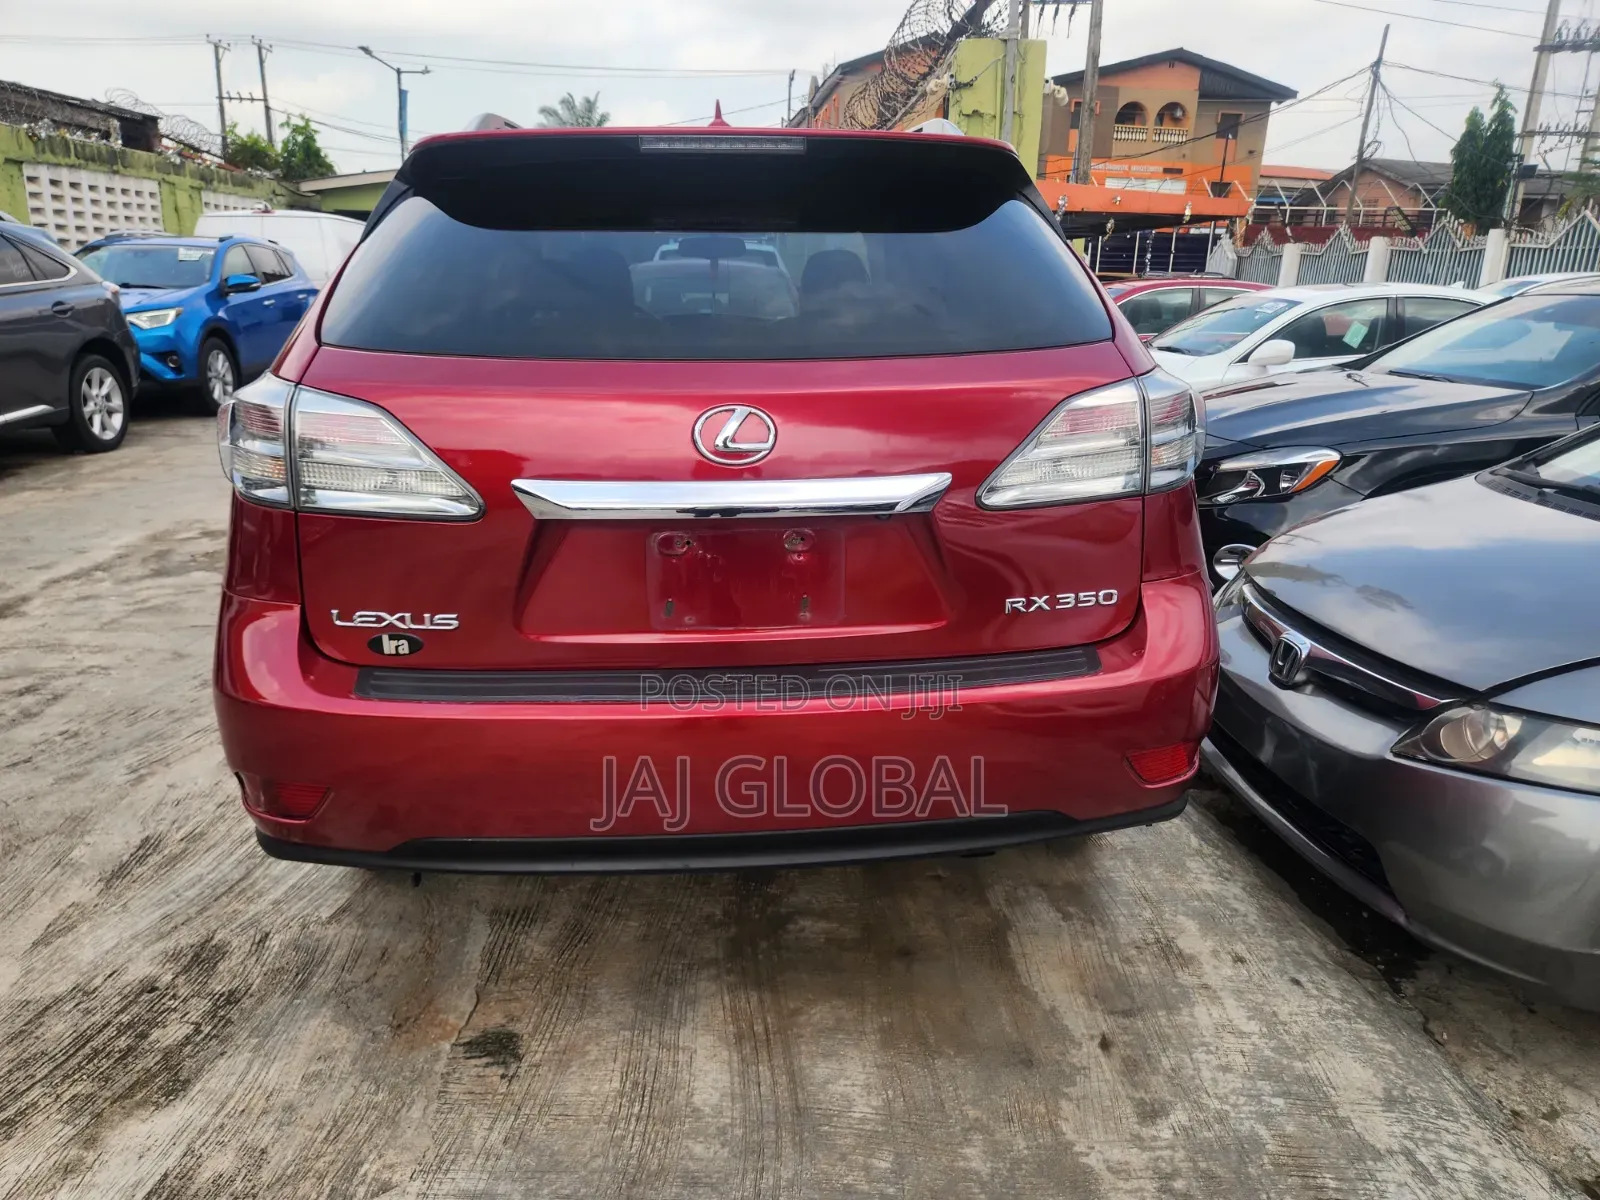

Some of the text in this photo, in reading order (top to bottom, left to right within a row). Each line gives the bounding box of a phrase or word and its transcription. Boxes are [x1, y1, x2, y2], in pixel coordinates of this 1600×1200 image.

[1005, 589, 1118, 614] RX 350
[331, 609, 459, 630] LEXUS
